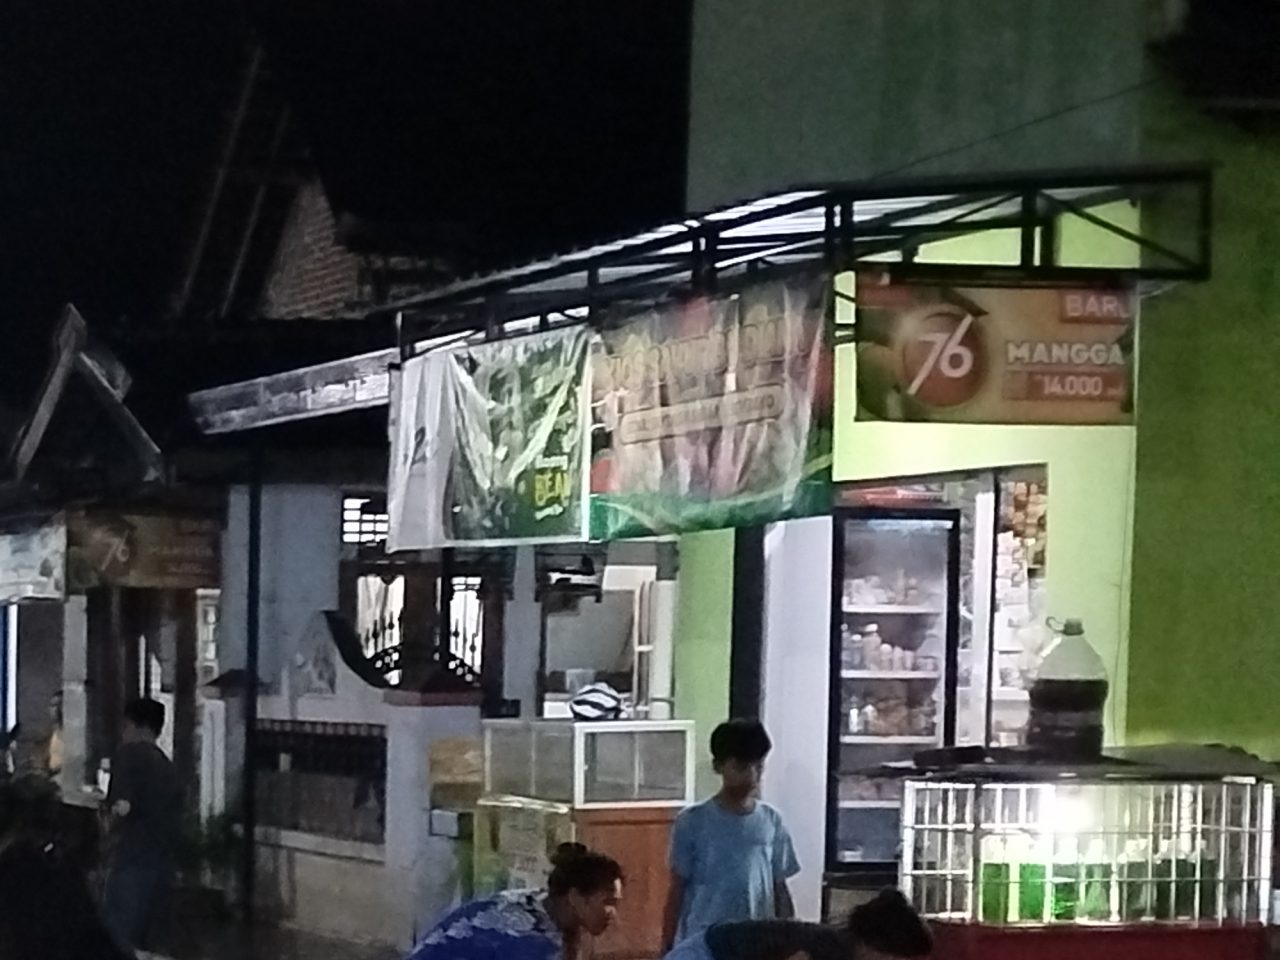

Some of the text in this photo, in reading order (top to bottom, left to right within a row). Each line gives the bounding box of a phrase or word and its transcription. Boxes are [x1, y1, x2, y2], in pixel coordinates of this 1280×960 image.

[907, 313, 975, 396] 76
[1006, 341, 1125, 366] MANGGA
[1042, 374, 1103, 396] 14.000
